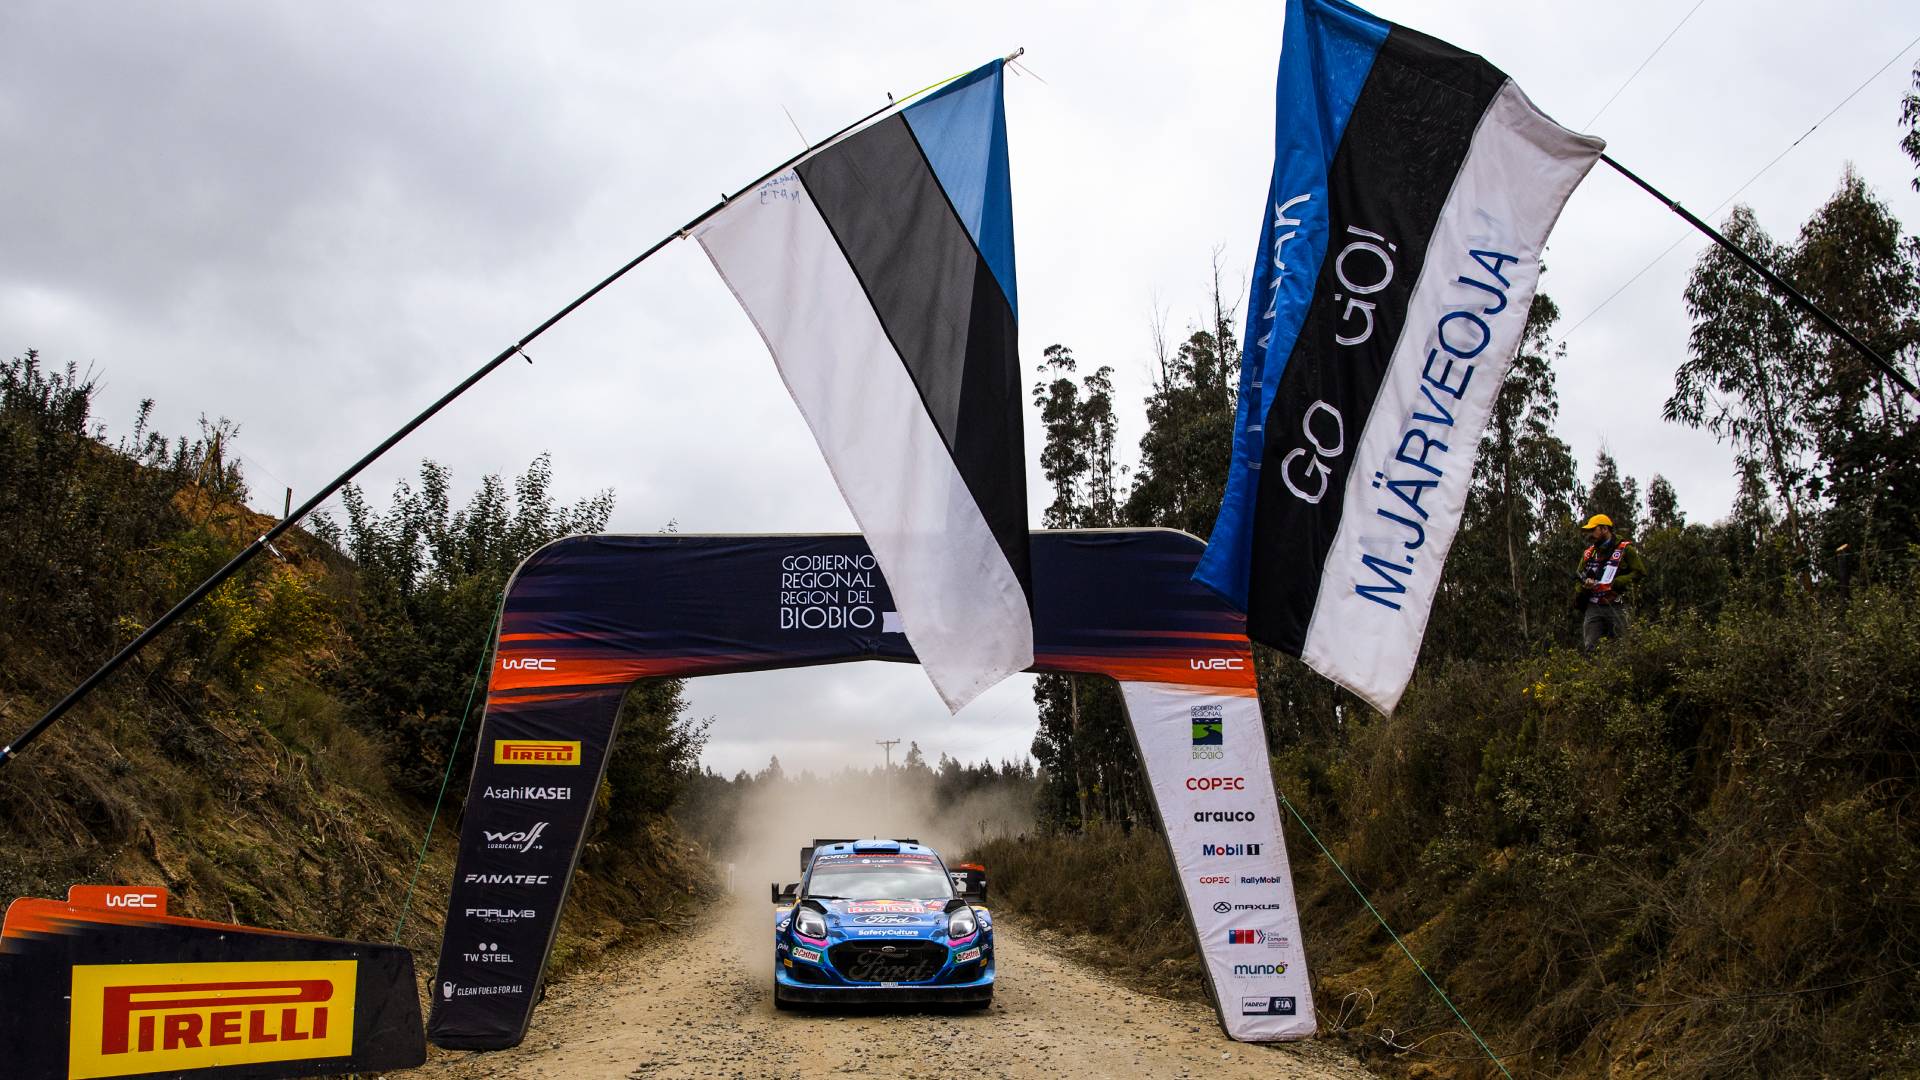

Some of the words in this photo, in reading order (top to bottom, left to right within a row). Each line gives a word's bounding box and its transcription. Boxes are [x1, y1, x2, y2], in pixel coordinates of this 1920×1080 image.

[1281, 400, 1344, 504] GO
[1336, 225, 1397, 346] GO!
[1355, 249, 1519, 610] M.JÄRVEOJA
[782, 555, 877, 571] GOBIERNO
[781, 572, 876, 588] REGIONAL
[780, 591, 839, 605] REGION
[847, 590, 874, 604] DEL
[780, 606, 875, 629] BIOBIO
[502, 658, 557, 671] WRC
[1190, 658, 1244, 670] WRC
[502, 744, 574, 761] PIRELLI
[1186, 777, 1245, 791] COPEC
[483, 786, 571, 800] AsahiKASEI
[1193, 811, 1256, 822] arauco
[1203, 843, 1244, 856] Mobil
[1247, 844, 1259, 856] 1
[464, 874, 550, 885] FANATEC
[1240, 877, 1281, 885] RallyMobil
[106, 893, 158, 908] WRC
[465, 908, 536, 918] FORUM8
[865, 913, 910, 924] Ford
[463, 953, 480, 962] TW
[481, 953, 514, 963] STEEL
[798, 948, 819, 961] Castrol
[457, 986, 478, 996] CLEAN
[479, 985, 498, 995] FUELS
[498, 985, 511, 994] FOR
[511, 984, 523, 993] ALL
[1274, 1000, 1292, 1010] FIA
[101, 979, 334, 1056] PIRELLI
